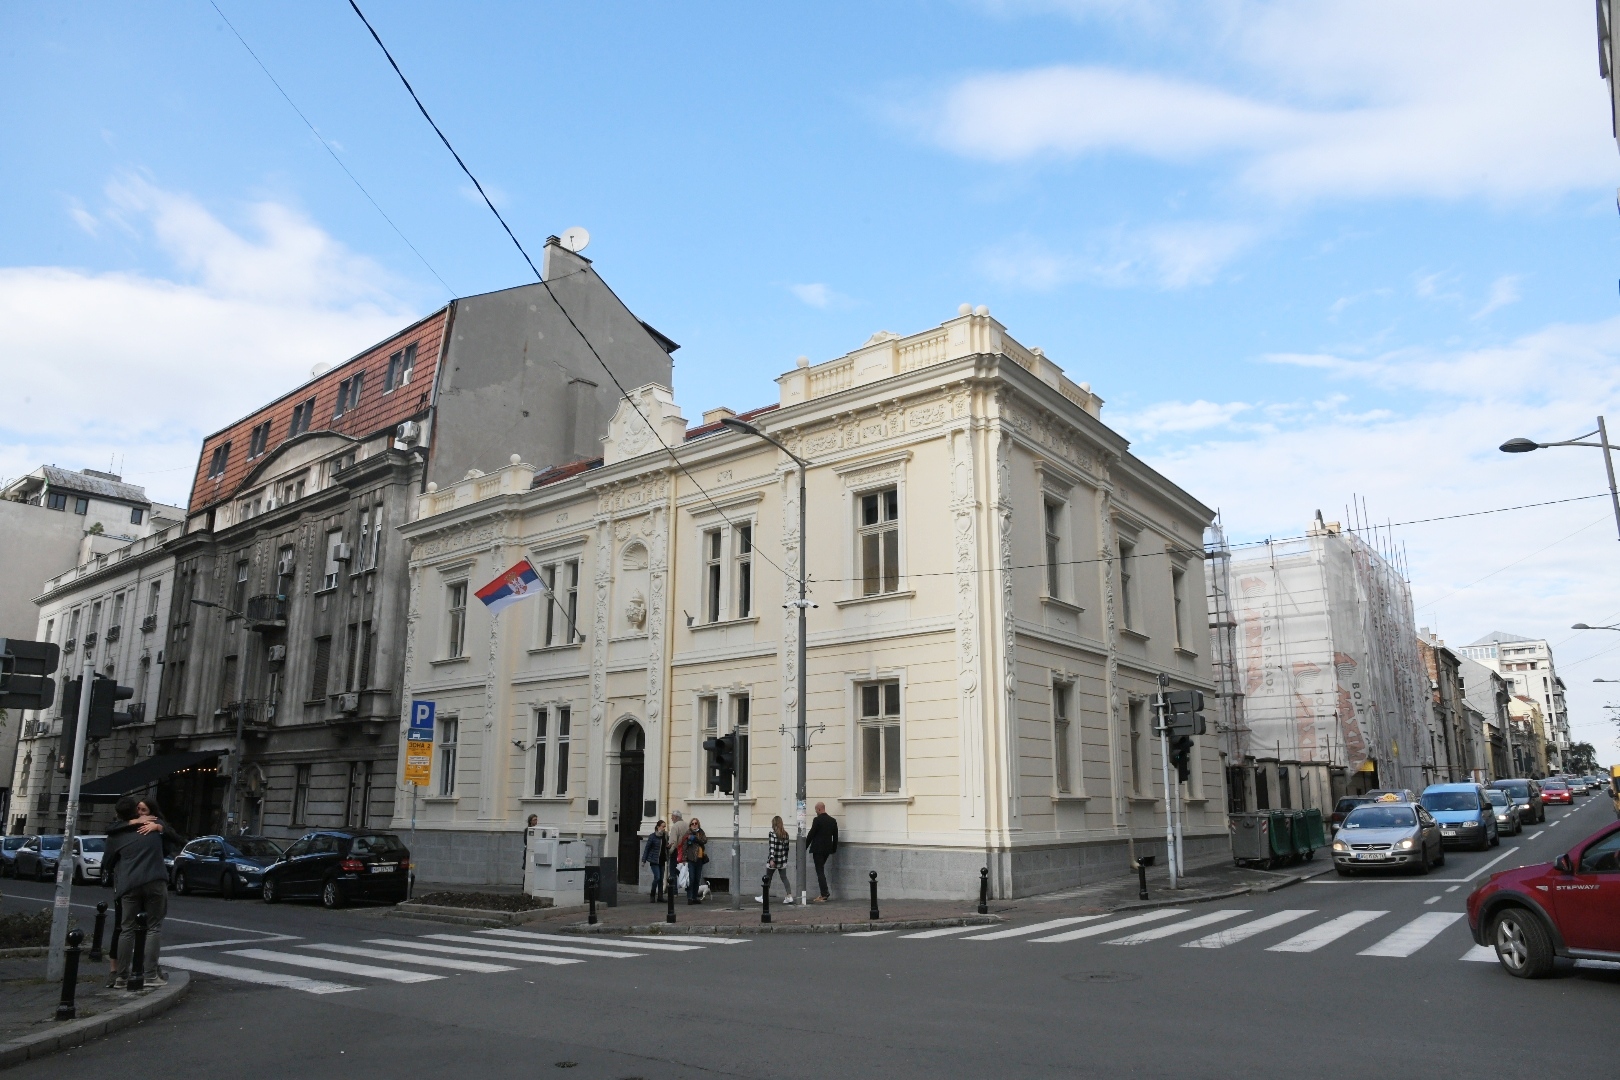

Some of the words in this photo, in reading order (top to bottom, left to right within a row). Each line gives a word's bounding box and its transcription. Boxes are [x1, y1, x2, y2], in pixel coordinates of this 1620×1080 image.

[1262, 601, 1271, 632] BOJE
[1264, 647, 1275, 694] FASADE
[1315, 689, 1326, 721] BOJE
[1351, 682, 1365, 715] BOJE
[416, 704, 430, 725] P
[1318, 737, 1329, 760] FAS
